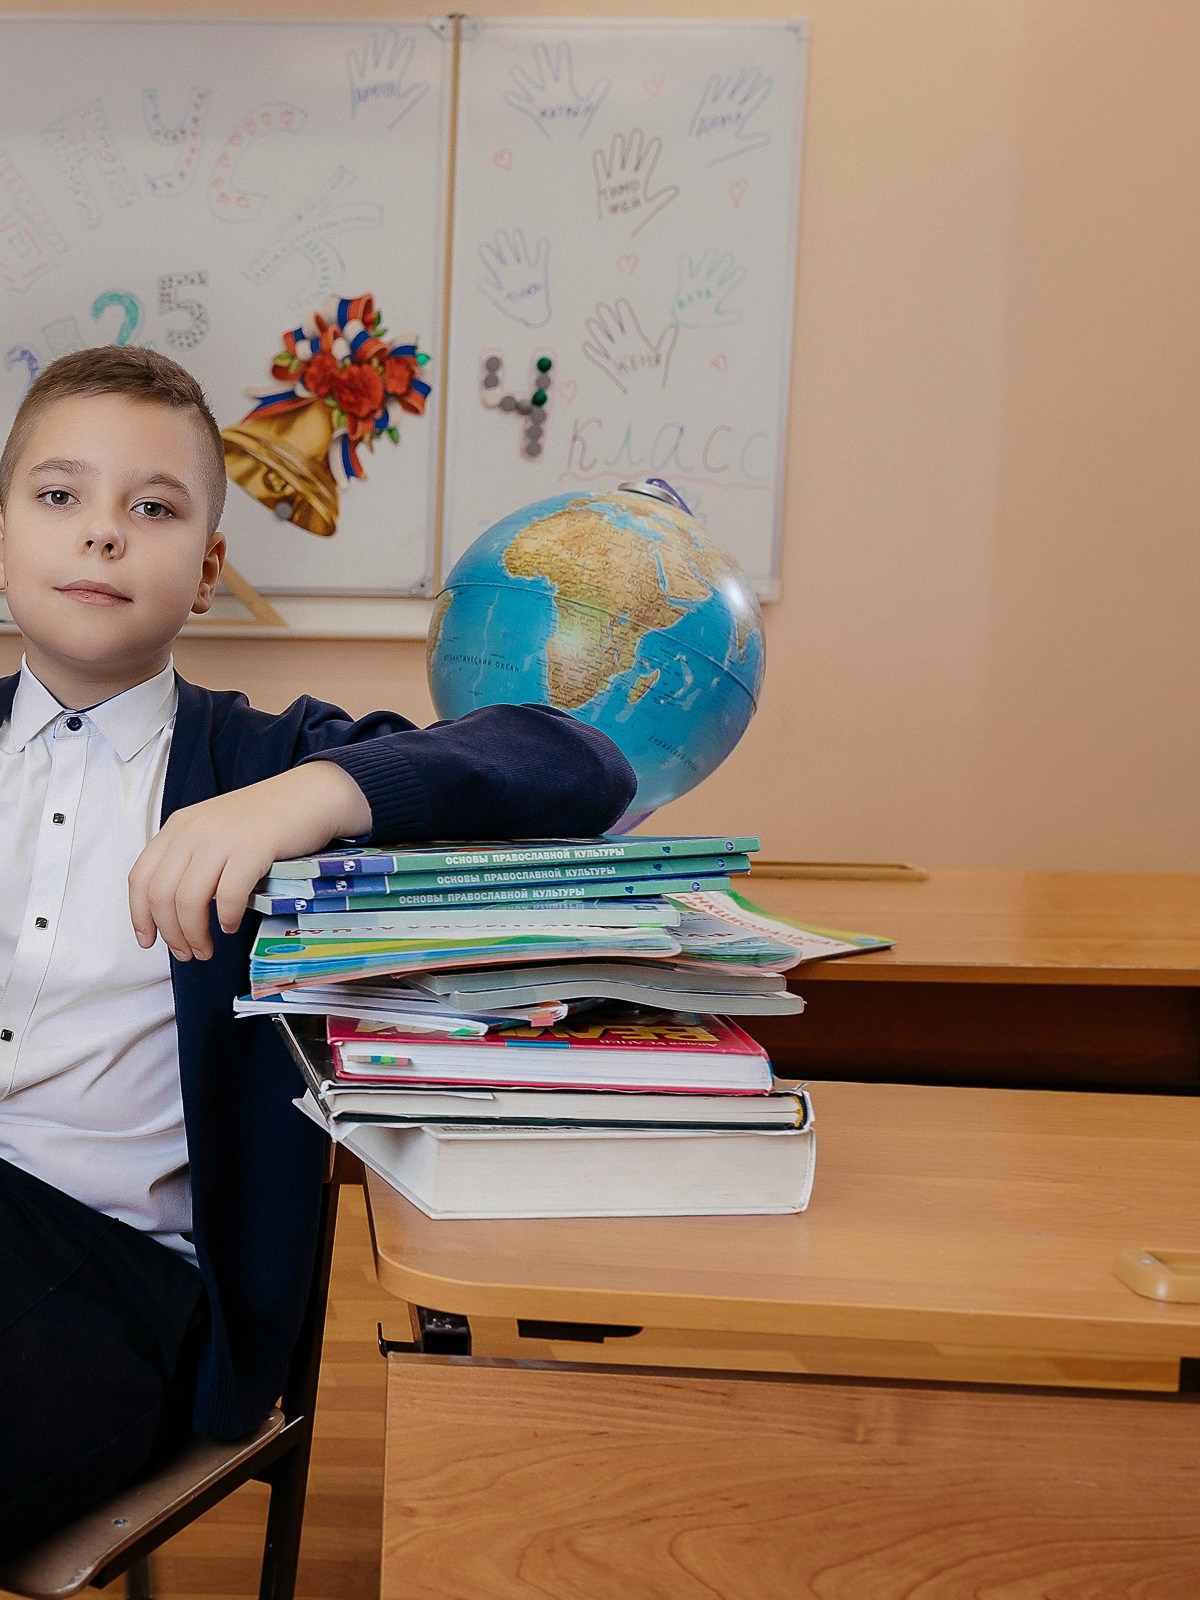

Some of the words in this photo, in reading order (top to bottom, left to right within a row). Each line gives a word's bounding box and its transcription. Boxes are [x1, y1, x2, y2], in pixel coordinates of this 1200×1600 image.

[478, 349, 557, 465] 4
[495, 660, 520, 673] ОКЕАН
[445, 854, 489, 866] ОСНОВЫ
[492, 848, 571, 864] ПРАВОСЛАВНОЙ
[574, 847, 625, 859] КУЛЬТУРЫ
[436, 874, 480, 885] ОСНОВЫ
[483, 868, 561, 882] ПРАВОСЛАВНОЙ
[565, 866, 616, 877] КУЛЬТУРЫ
[399, 894, 443, 904] ОСНОВЫ
[448, 888, 528, 902] ПРАВОСЛАВНОЙ
[532, 887, 585, 899] КУЛЬТУРЫ
